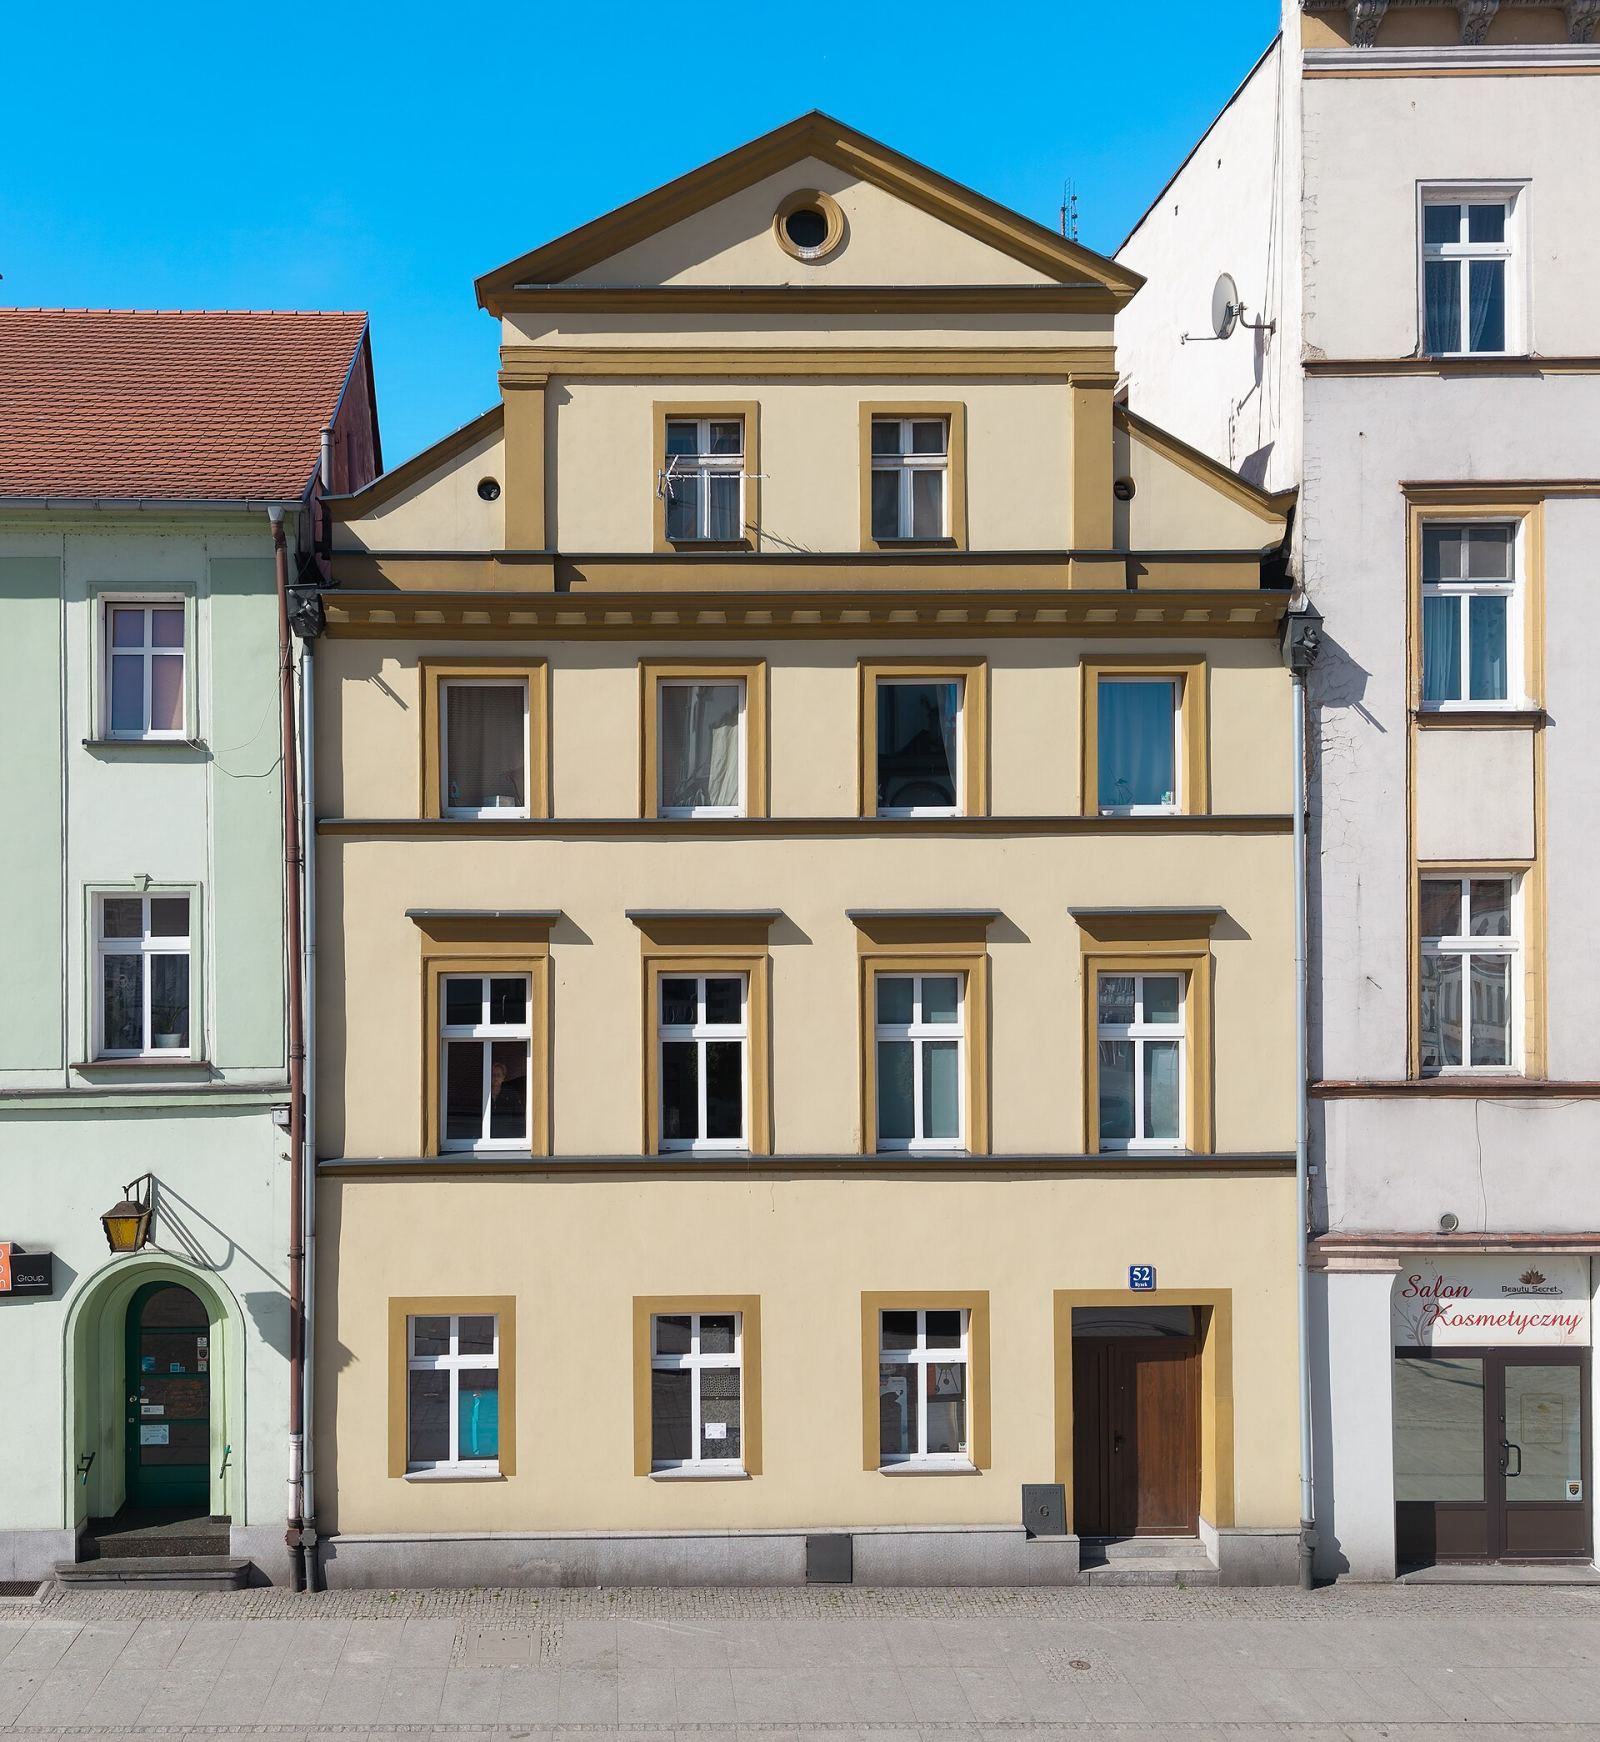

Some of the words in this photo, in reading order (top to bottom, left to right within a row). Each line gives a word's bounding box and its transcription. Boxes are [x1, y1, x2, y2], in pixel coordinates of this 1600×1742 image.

[17, 1274, 44, 1282] Group
[1133, 1267, 1150, 1280] 52
[1402, 1274, 1473, 1298] Salon
[1501, 1285, 1530, 1294] Beauty
[1532, 1285, 1558, 1293] Secret
[1423, 1303, 1583, 1334] Kosmetyczny
